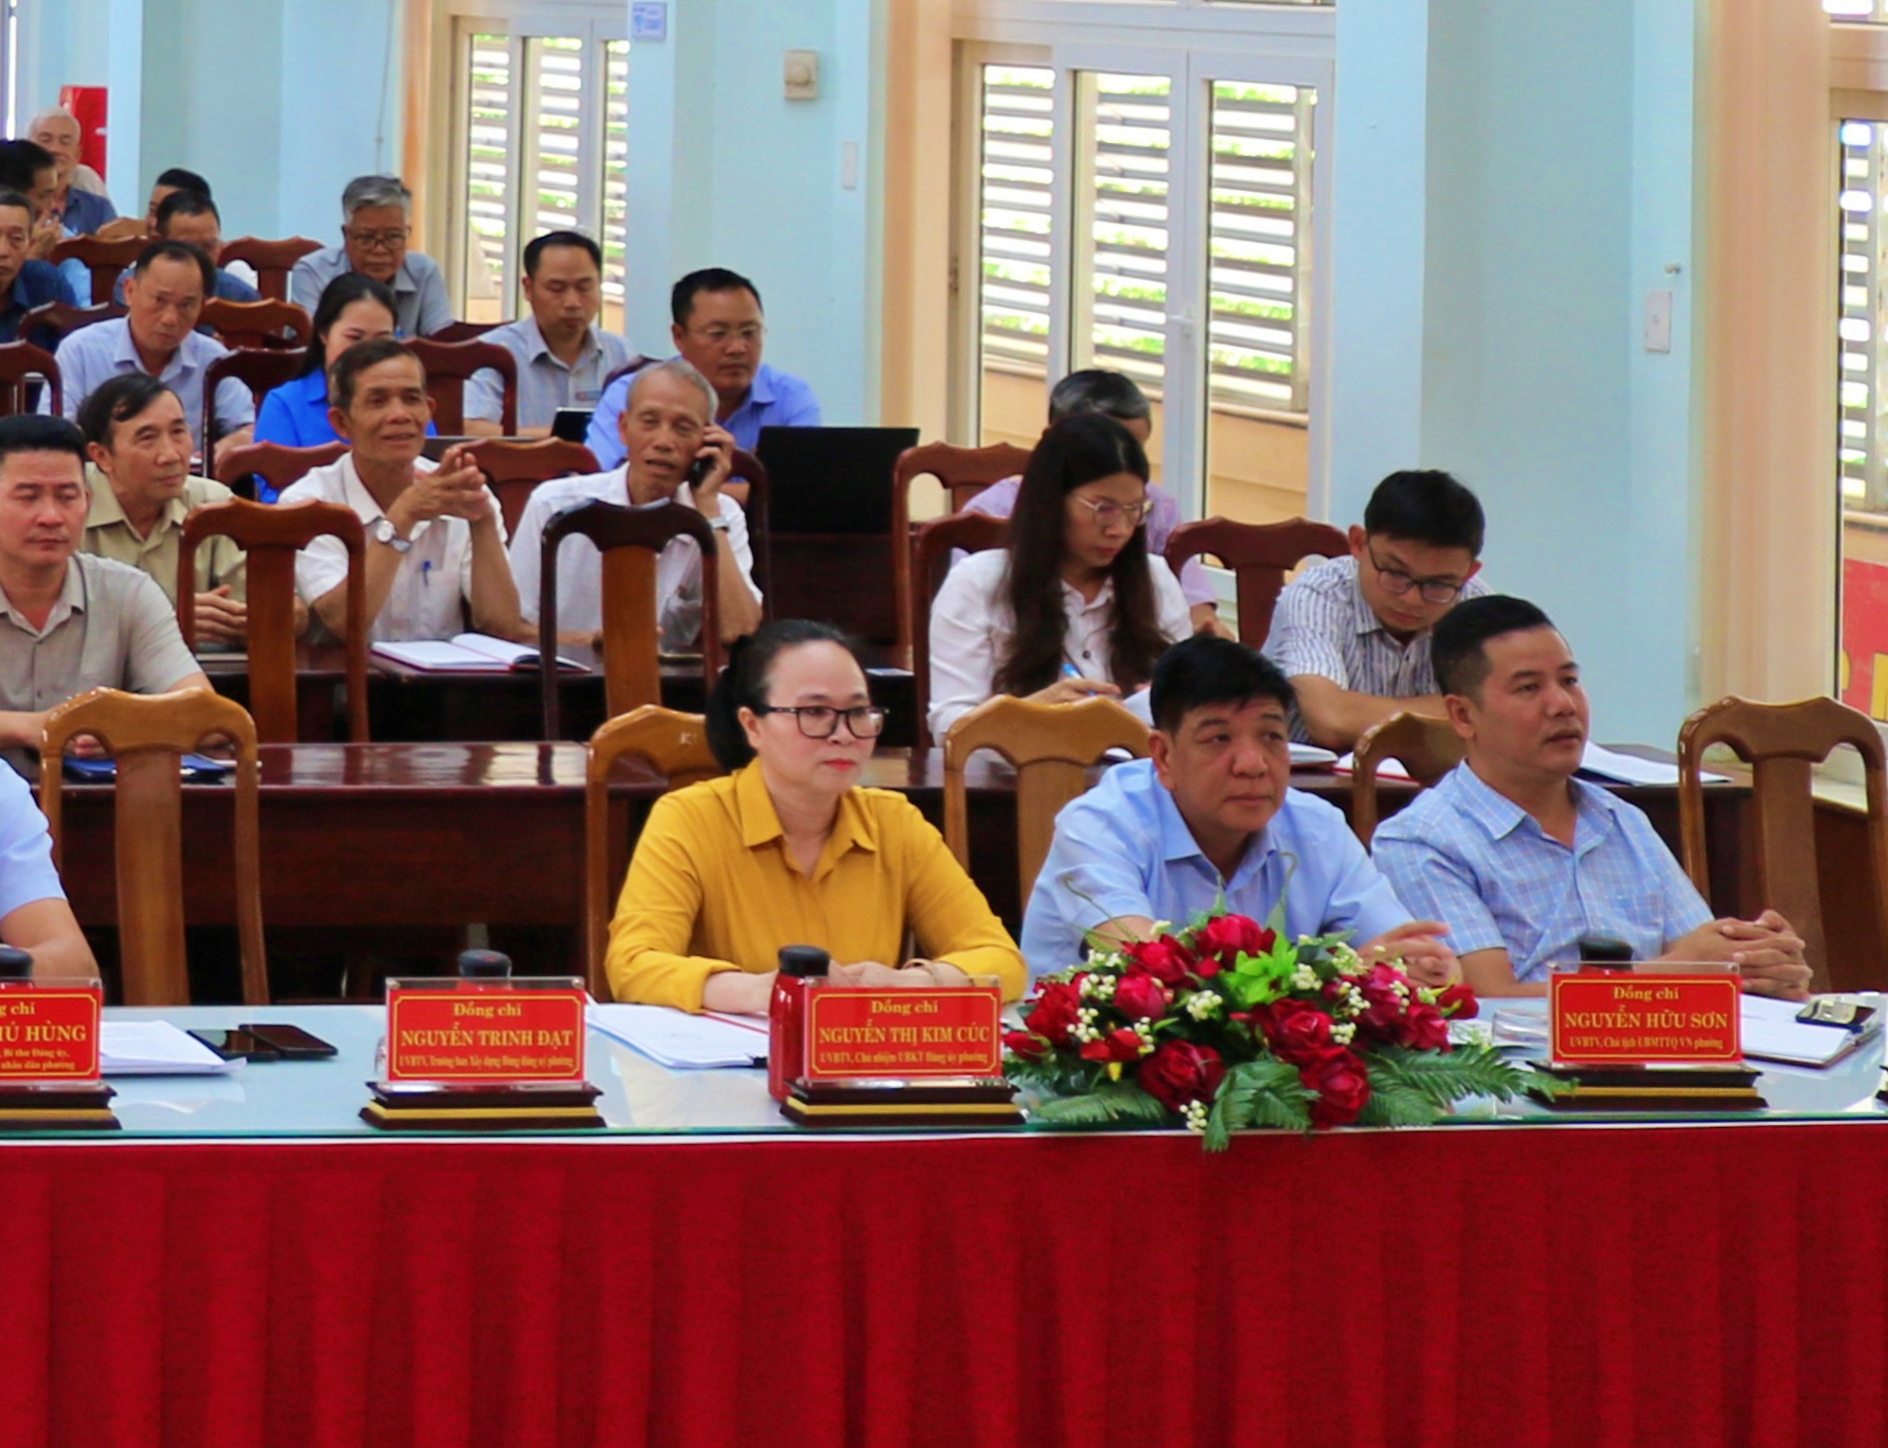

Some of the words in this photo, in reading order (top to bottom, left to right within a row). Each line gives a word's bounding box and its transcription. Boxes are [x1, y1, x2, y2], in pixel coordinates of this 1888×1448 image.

[1656, 987, 1679, 999] chí
[10, 1001, 35, 1015] chí
[498, 1003, 521, 1016] chí
[914, 1000, 938, 1013] chí
[1564, 1005, 1641, 1028] NGUYỄN
[1646, 1009, 1686, 1028] HỮU
[1690, 1012, 1728, 1028] SƠN
[26, 1020, 87, 1042] HÙNG
[400, 1022, 474, 1046] NGUYỄN
[477, 1030, 533, 1046] TRINH
[537, 1030, 573, 1049] ĐẠT
[819, 1018, 886, 1043] NGUYỄN
[890, 1027, 918, 1046] THỊ
[922, 1027, 952, 1042] KIM
[957, 1022, 990, 1042] CÚC
